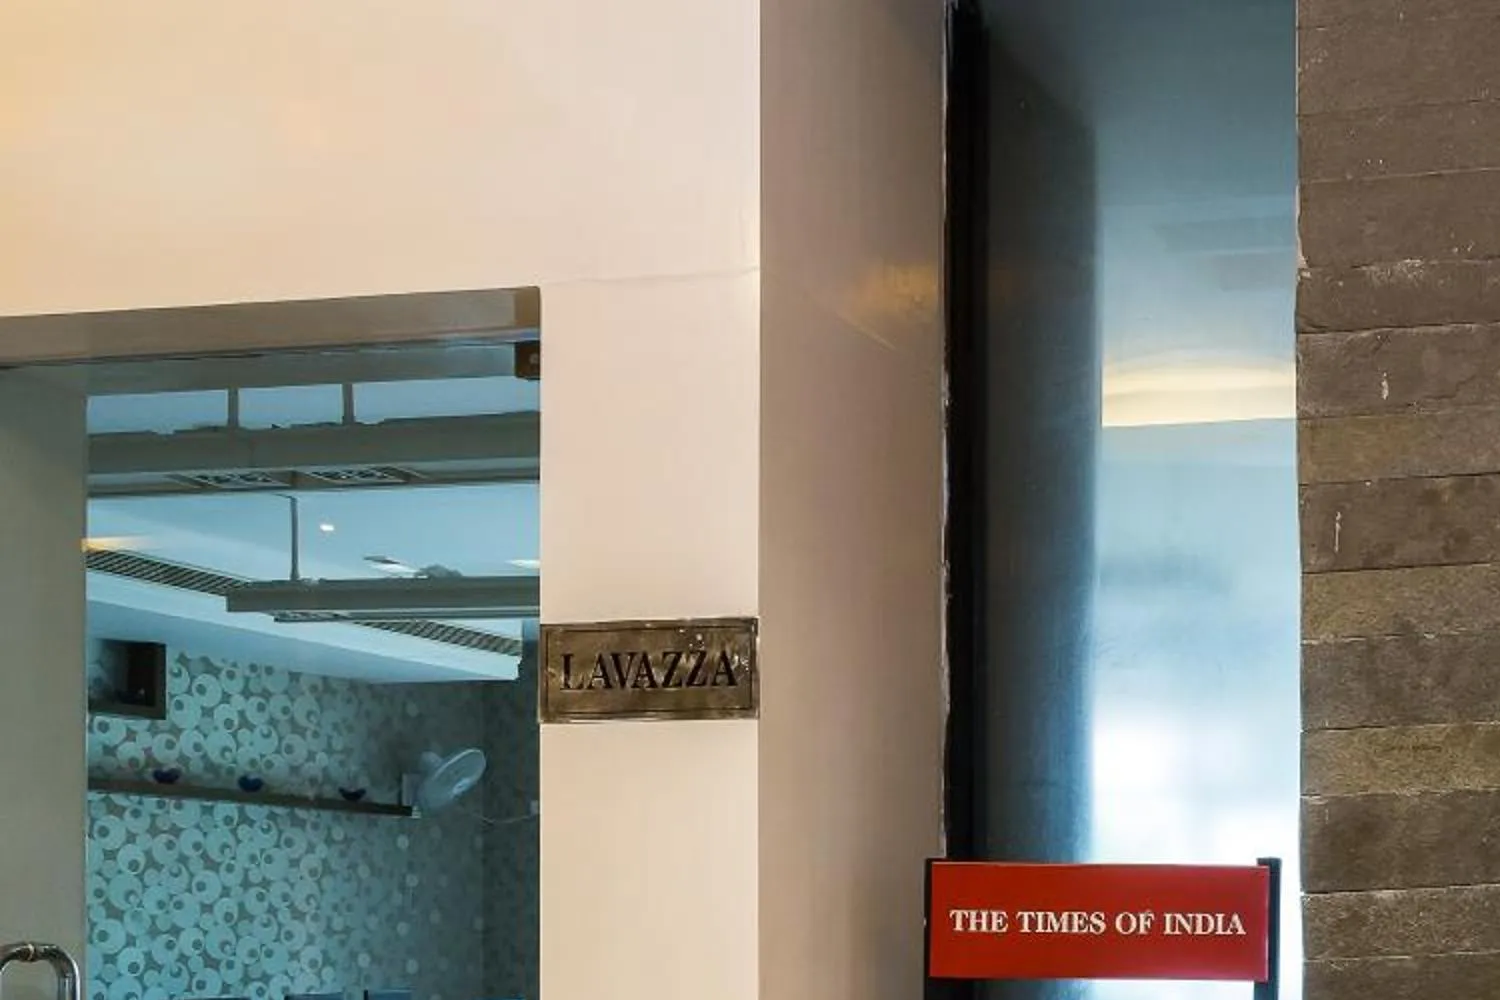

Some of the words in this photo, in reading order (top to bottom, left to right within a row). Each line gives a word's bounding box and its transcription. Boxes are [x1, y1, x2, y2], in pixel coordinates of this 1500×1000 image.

[560, 650, 738, 690] LAVAZZA
[949, 909, 1008, 933] THE
[1016, 911, 1107, 934] TIMES
[1114, 911, 1154, 935] OF
[1163, 912, 1246, 935] INDIA
